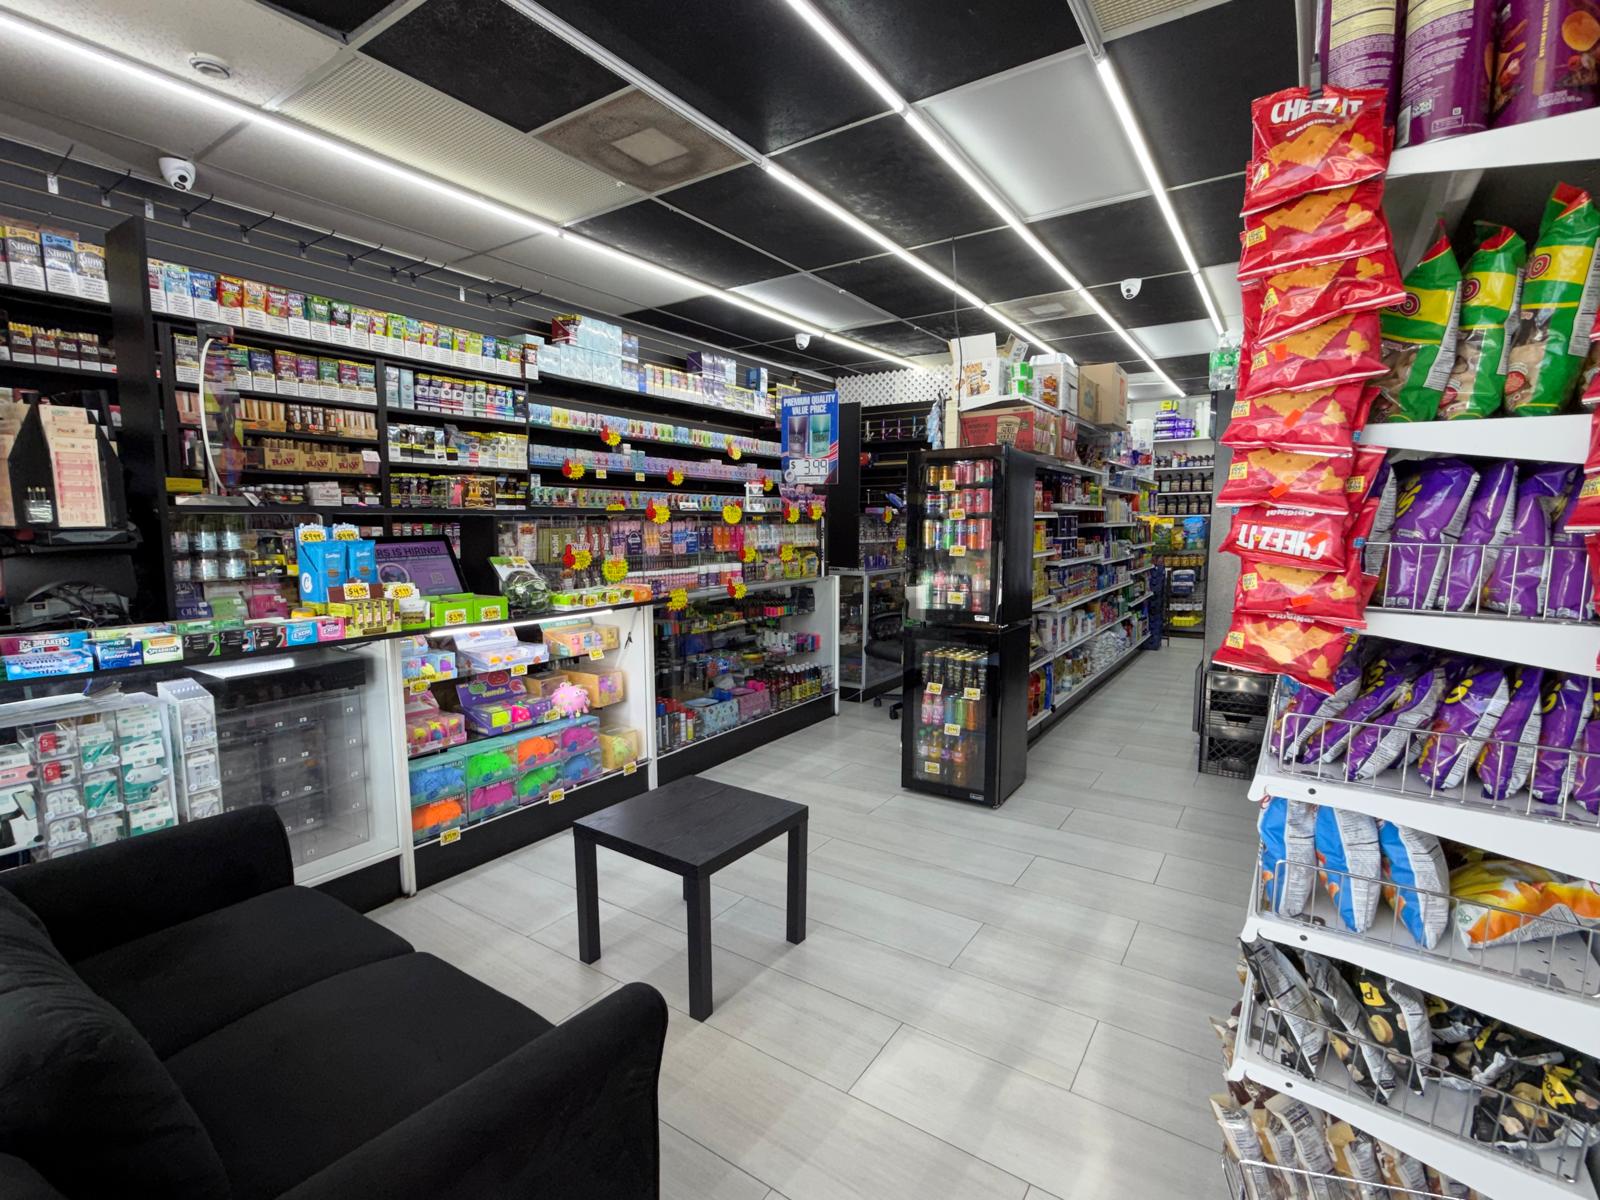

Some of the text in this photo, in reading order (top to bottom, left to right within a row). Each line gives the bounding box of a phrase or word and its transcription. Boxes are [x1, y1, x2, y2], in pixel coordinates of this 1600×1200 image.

[783, 394, 836, 407] PREMIUM QUALITY
[792, 404, 827, 416] VALUE PRICE
[406, 546, 440, 555] HIRING!
[33, 637, 70, 649] BREAKERS
